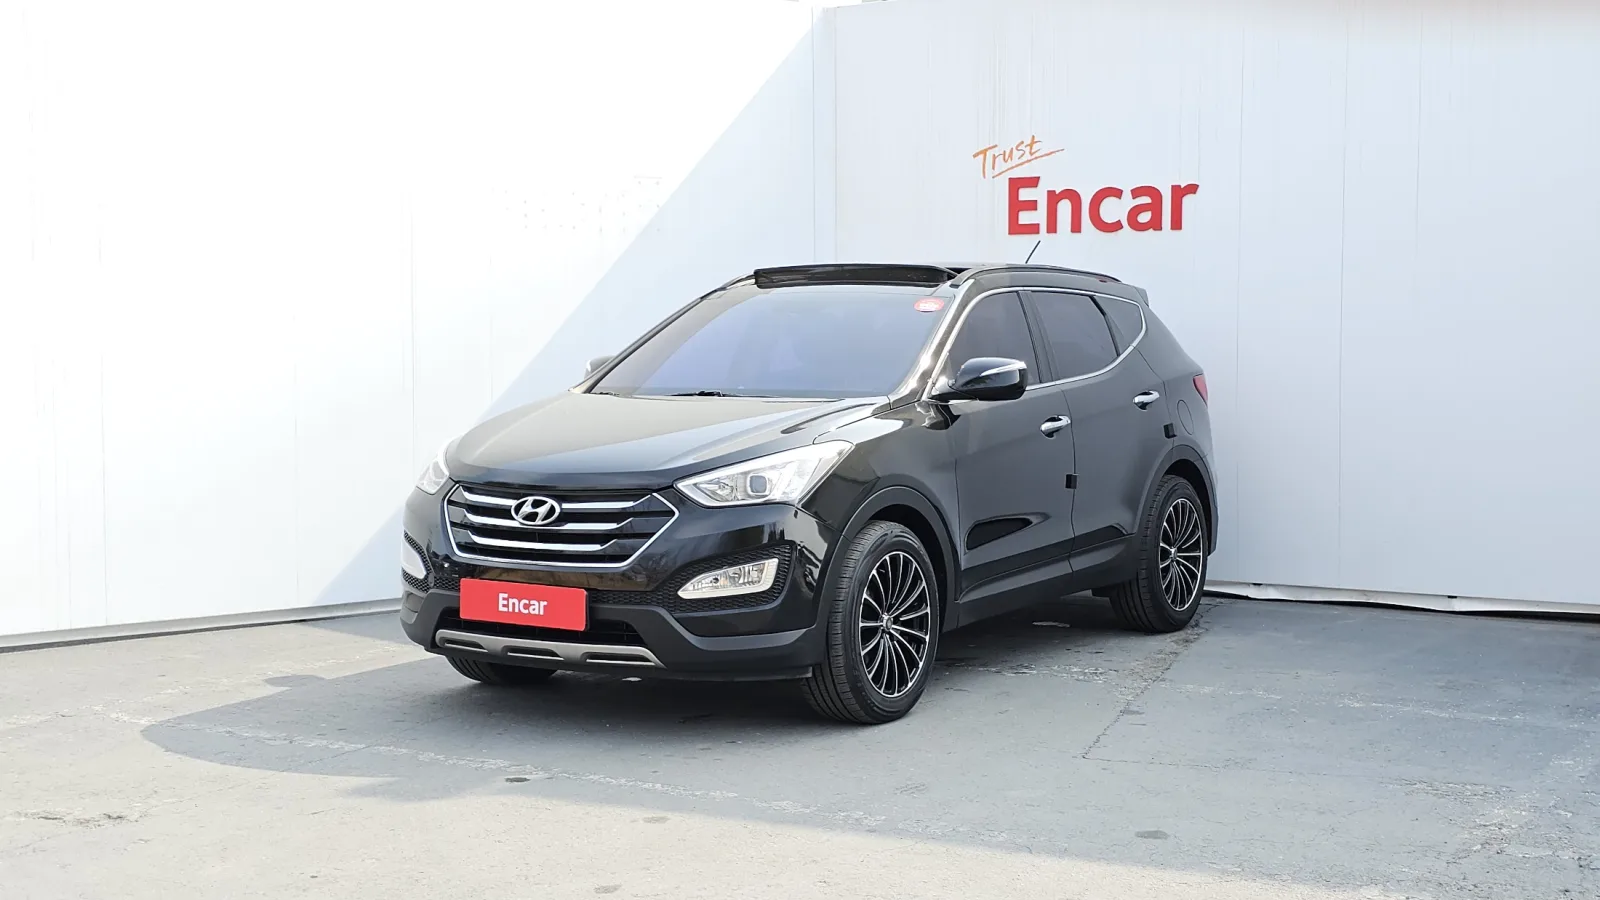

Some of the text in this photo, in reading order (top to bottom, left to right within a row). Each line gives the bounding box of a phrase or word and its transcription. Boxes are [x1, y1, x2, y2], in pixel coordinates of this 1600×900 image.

[972, 135, 1042, 178] Trust
[1008, 176, 1199, 235] Encar
[498, 592, 548, 615] Encar
